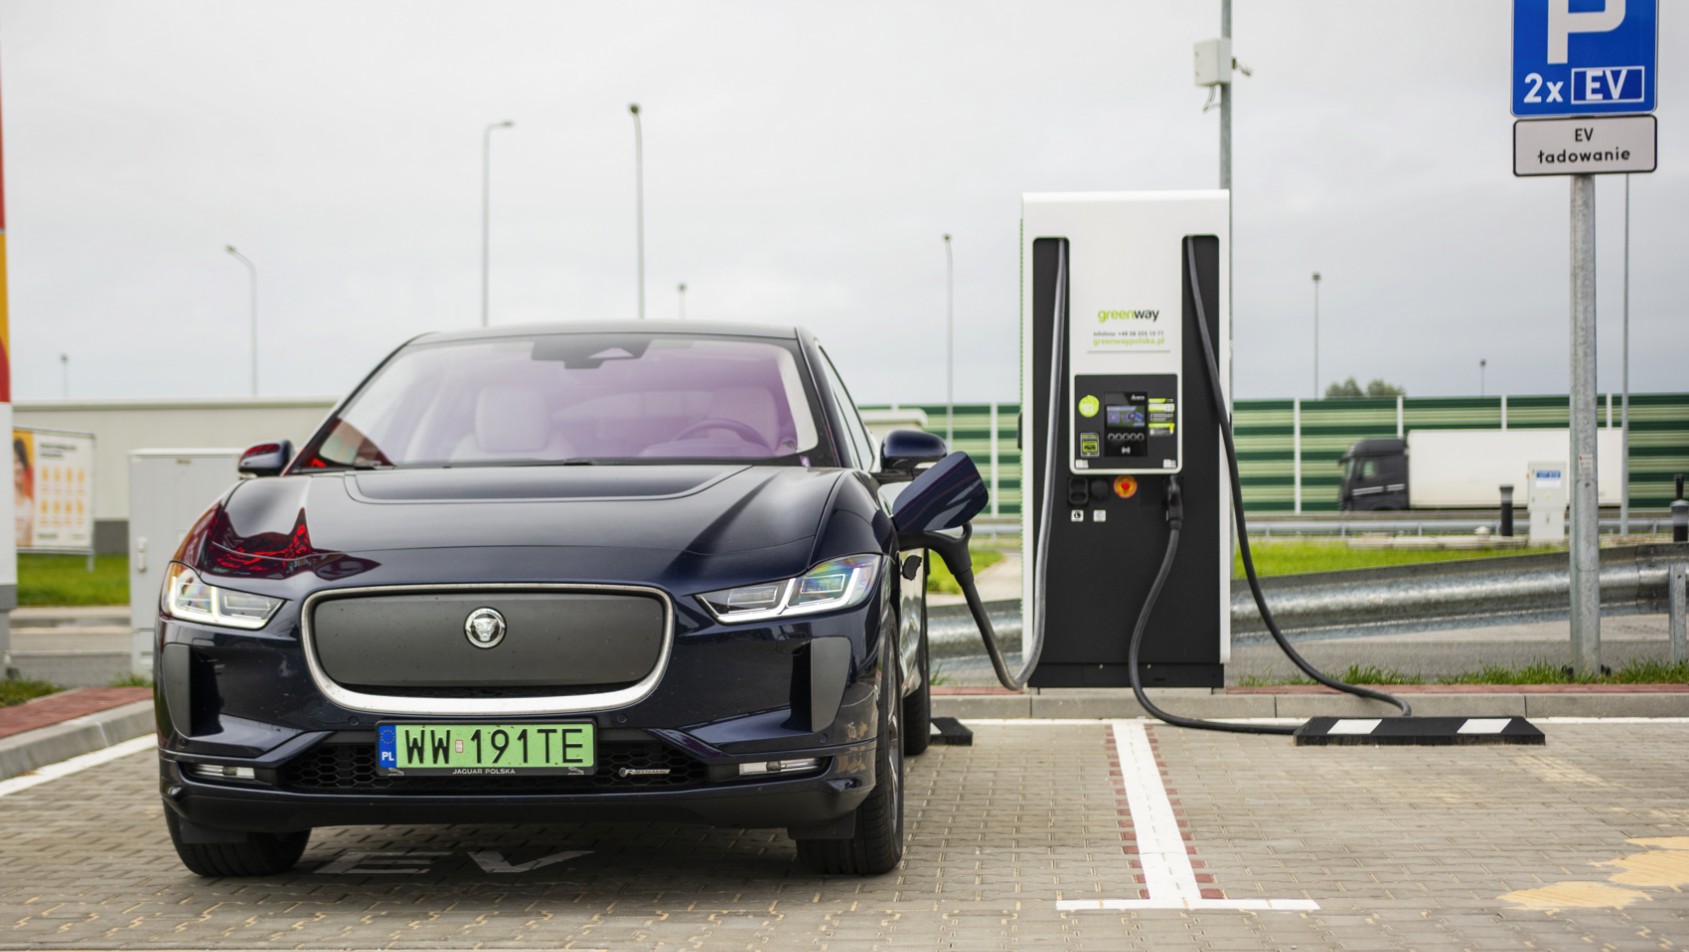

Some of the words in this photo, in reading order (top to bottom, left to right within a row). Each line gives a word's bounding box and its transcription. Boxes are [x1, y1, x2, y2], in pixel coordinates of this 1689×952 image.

[1547, 0, 1626, 64] P
[1523, 72, 1564, 103] 2x
[1585, 70, 1628, 100] EV
[1574, 128, 1594, 142] EV
[1537, 147, 1631, 164] ładowanie
[1097, 309, 1160, 323] greenway
[381, 751, 394, 761] PL
